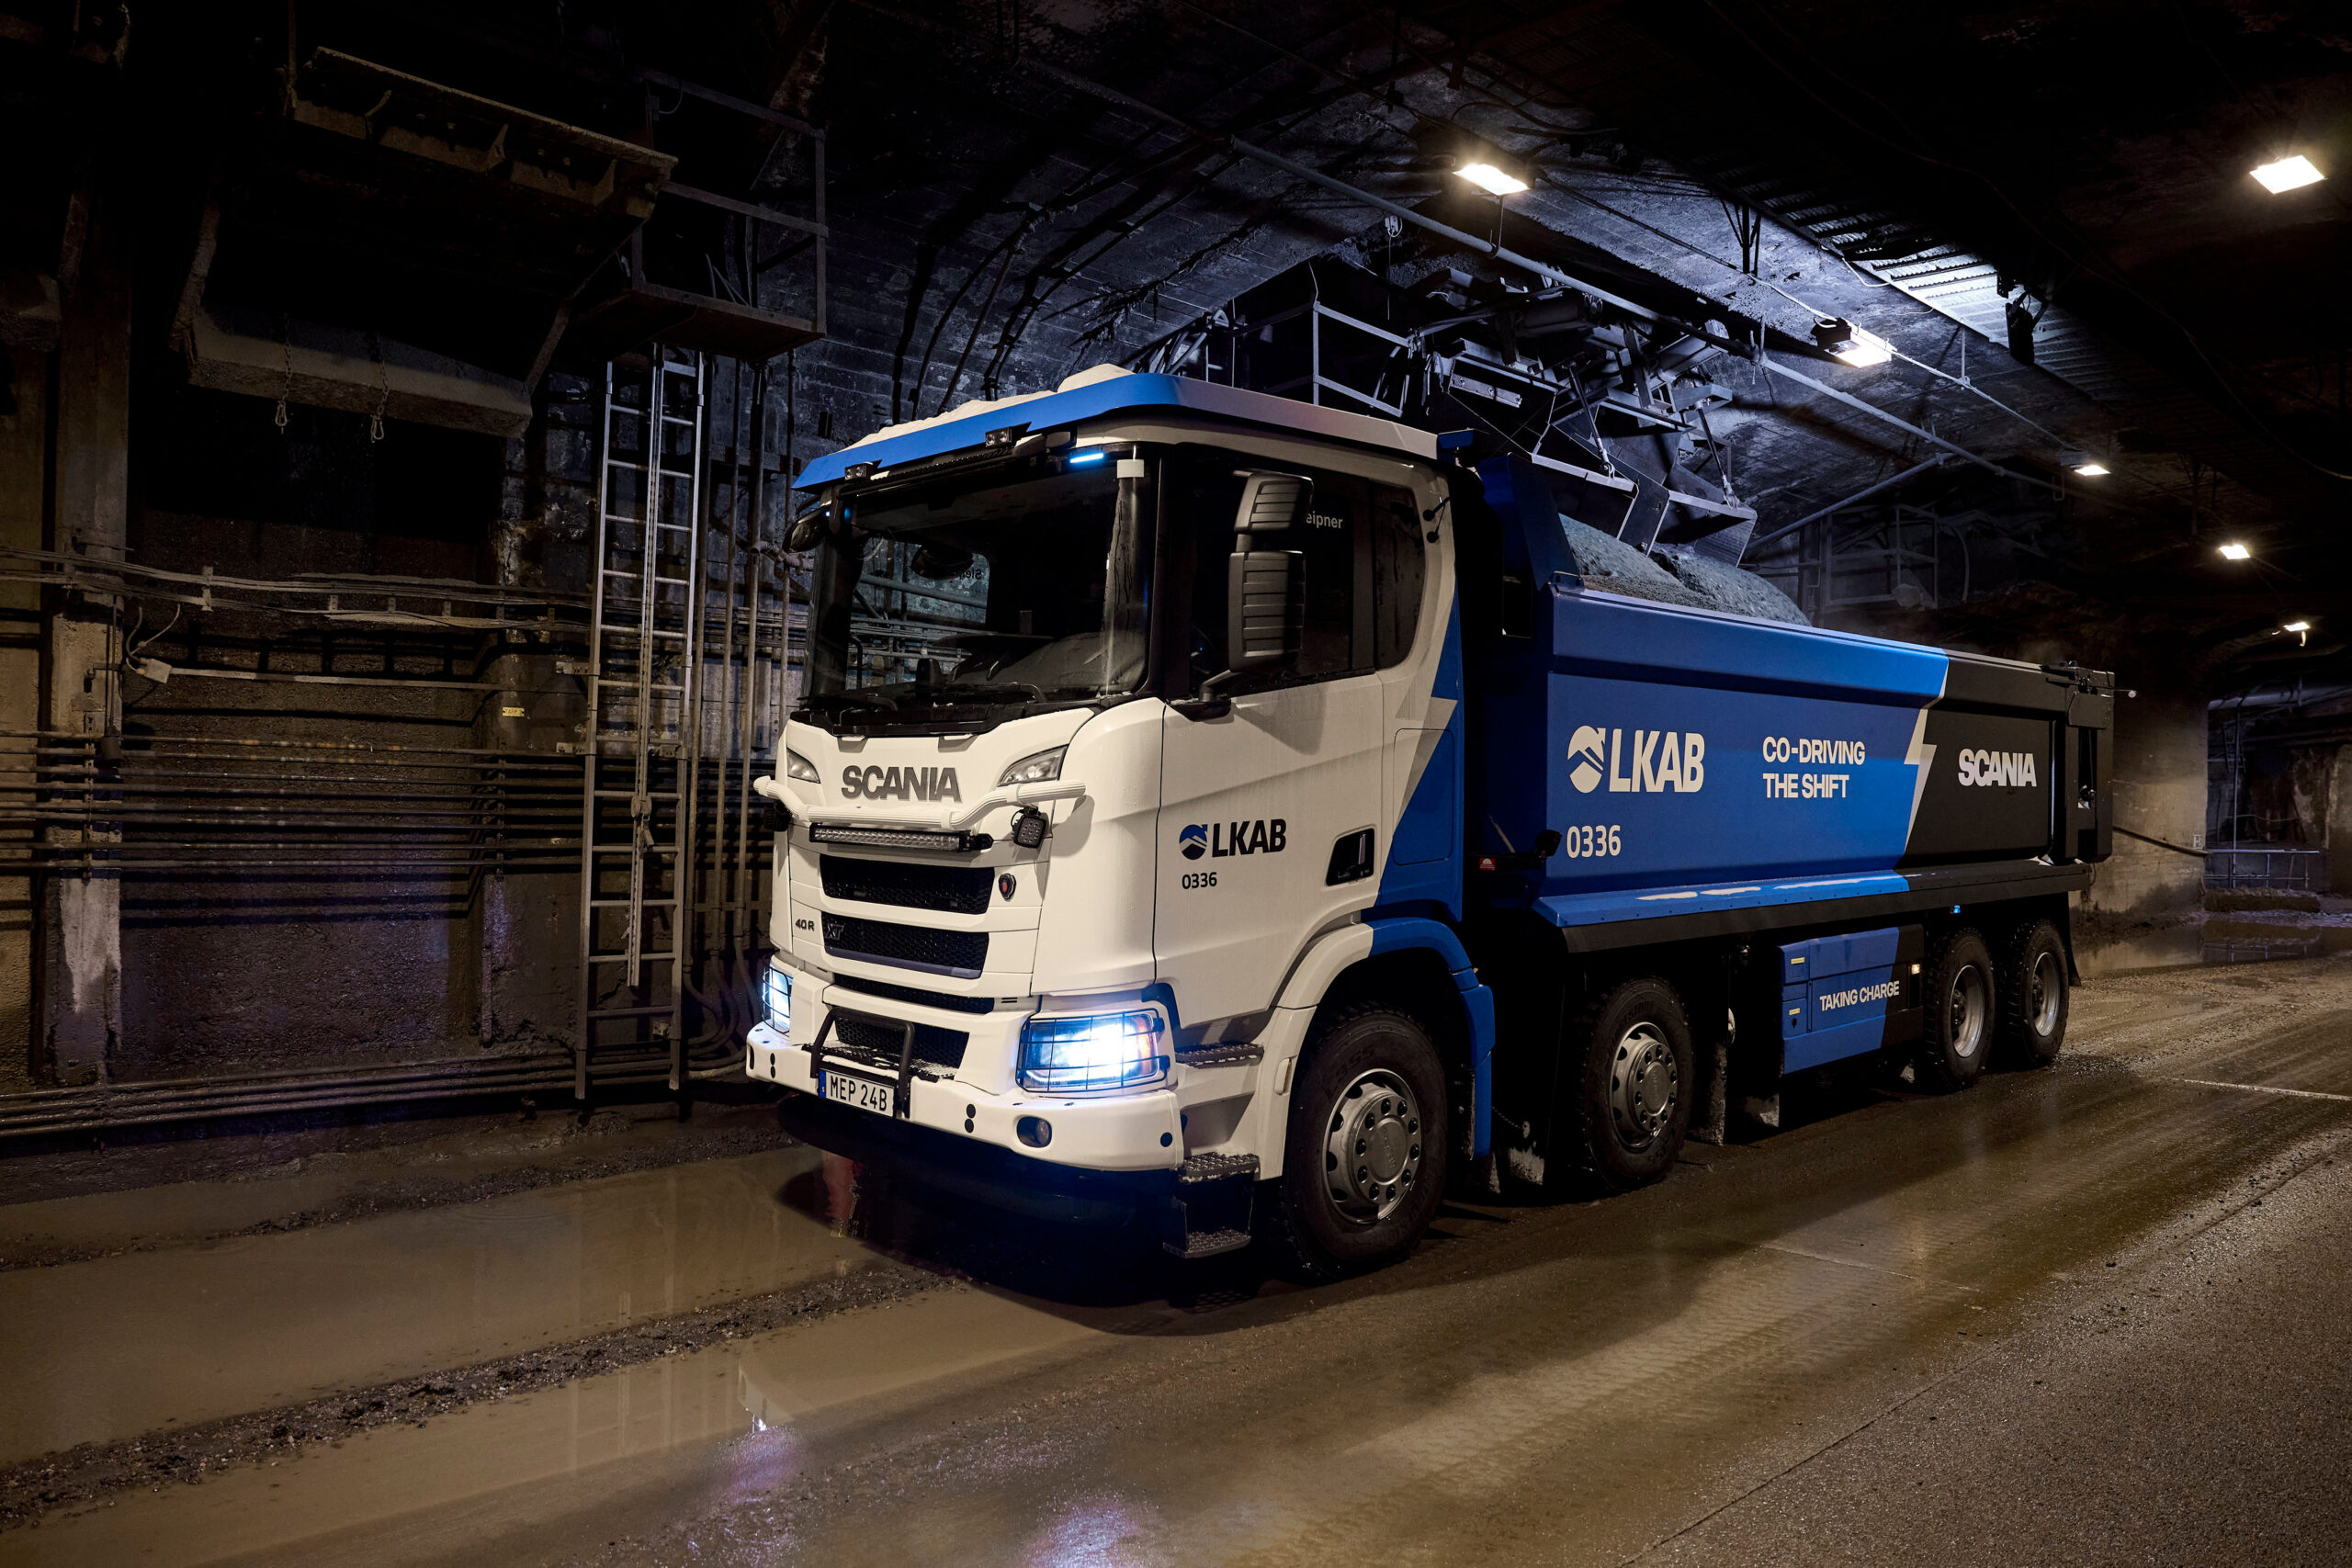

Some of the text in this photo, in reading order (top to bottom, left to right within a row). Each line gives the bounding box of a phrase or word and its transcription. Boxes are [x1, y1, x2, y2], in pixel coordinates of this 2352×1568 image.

[1306, 511, 1343, 528] eipner
[1609, 728, 1705, 793] LKAB
[1762, 736, 1865, 765] CO-DRIVING
[841, 765, 962, 803] SCANIA
[1958, 748, 2037, 787] SCANIA
[1762, 773, 1849, 798] THE SHIFT
[1212, 818, 1286, 858] LKAB
[1566, 825, 1622, 858] 0336
[1182, 872, 1218, 889] 0336
[1820, 980, 1900, 1011] TAKING CHARGE
[830, 1075, 856, 1102] MEP
[860, 1083, 888, 1111] 24B
